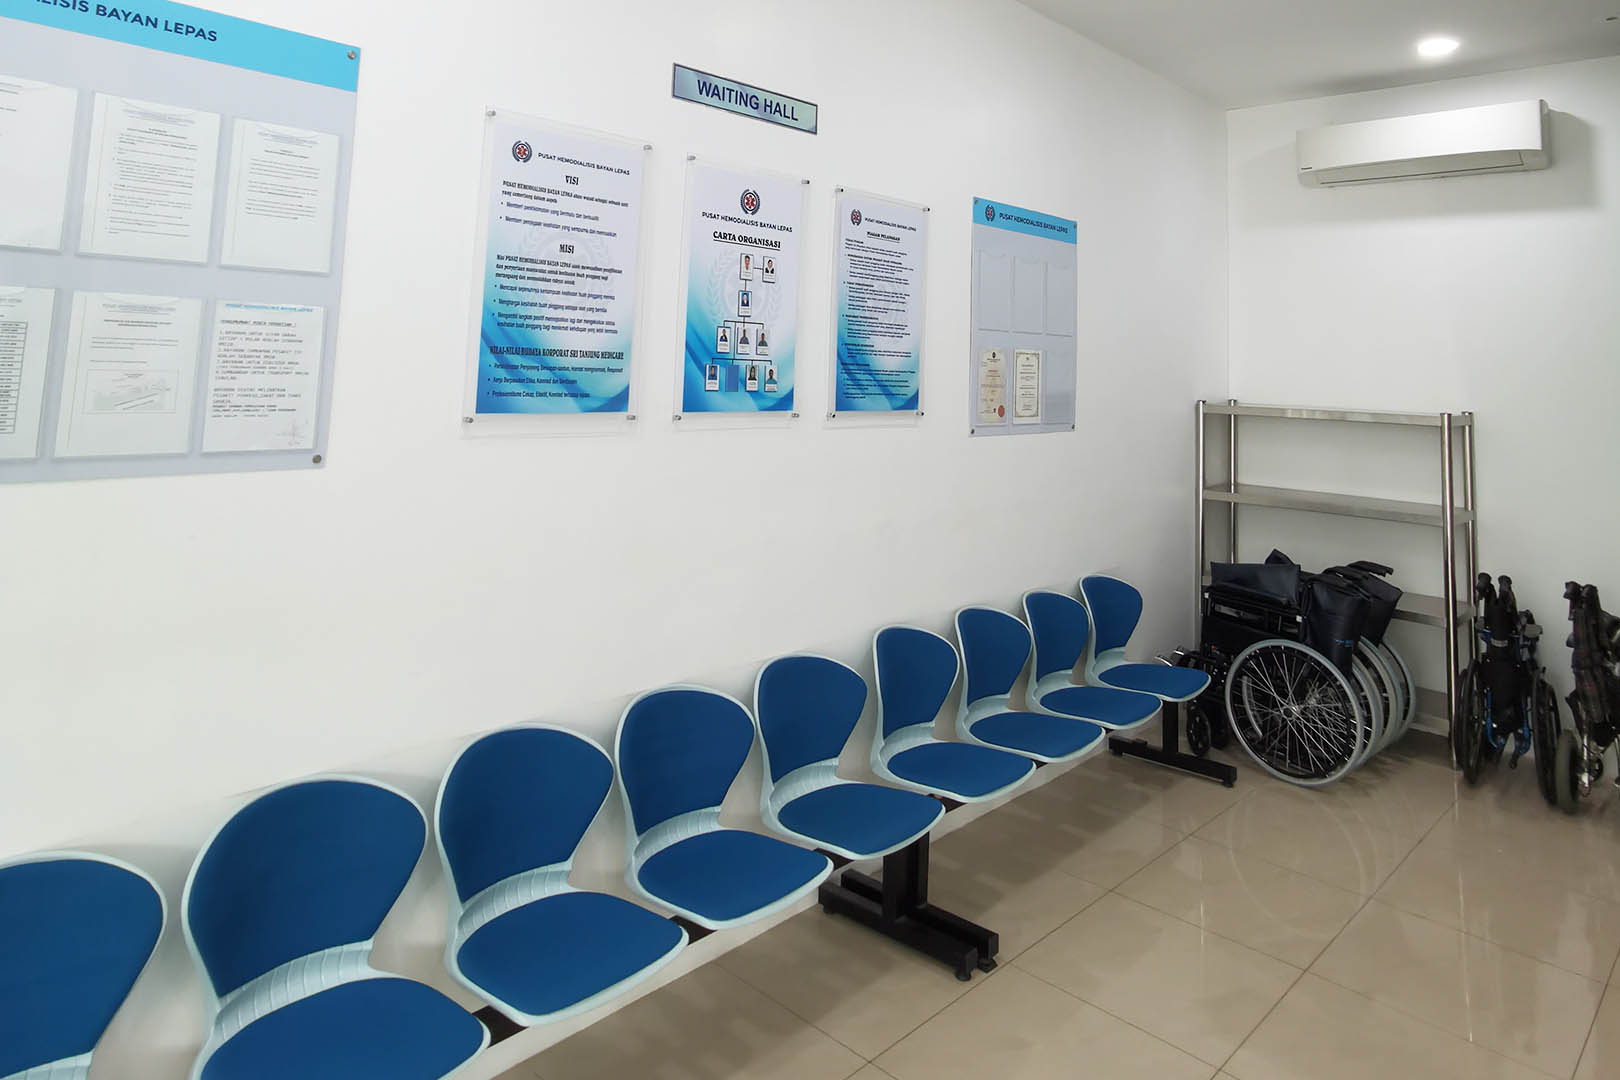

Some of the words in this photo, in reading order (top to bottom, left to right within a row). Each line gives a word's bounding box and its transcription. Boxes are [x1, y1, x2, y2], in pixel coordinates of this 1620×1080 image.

[95, 4, 158, 29] BAYAN
[164, 19, 218, 42] LEPAS
[697, 79, 759, 110] WAITING
[763, 98, 799, 121] HALL
[538, 152, 556, 160] PUSAT
[557, 156, 595, 168] HEMODIALISIS
[597, 164, 613, 172] BAYAN
[614, 167, 630, 175] LEPAS
[565, 175, 579, 185] VISI
[702, 212, 719, 220] PUSAT
[721, 215, 758, 227] HEMODIALISIS
[760, 222, 776, 230] BAYAN
[713, 231, 736, 241] CARTA
[738, 235, 781, 248] ORGANISASI
[560, 244, 574, 254] MISI
[542, 348, 569, 358] KORPORAT
[601, 351, 624, 360] MEDICARE
